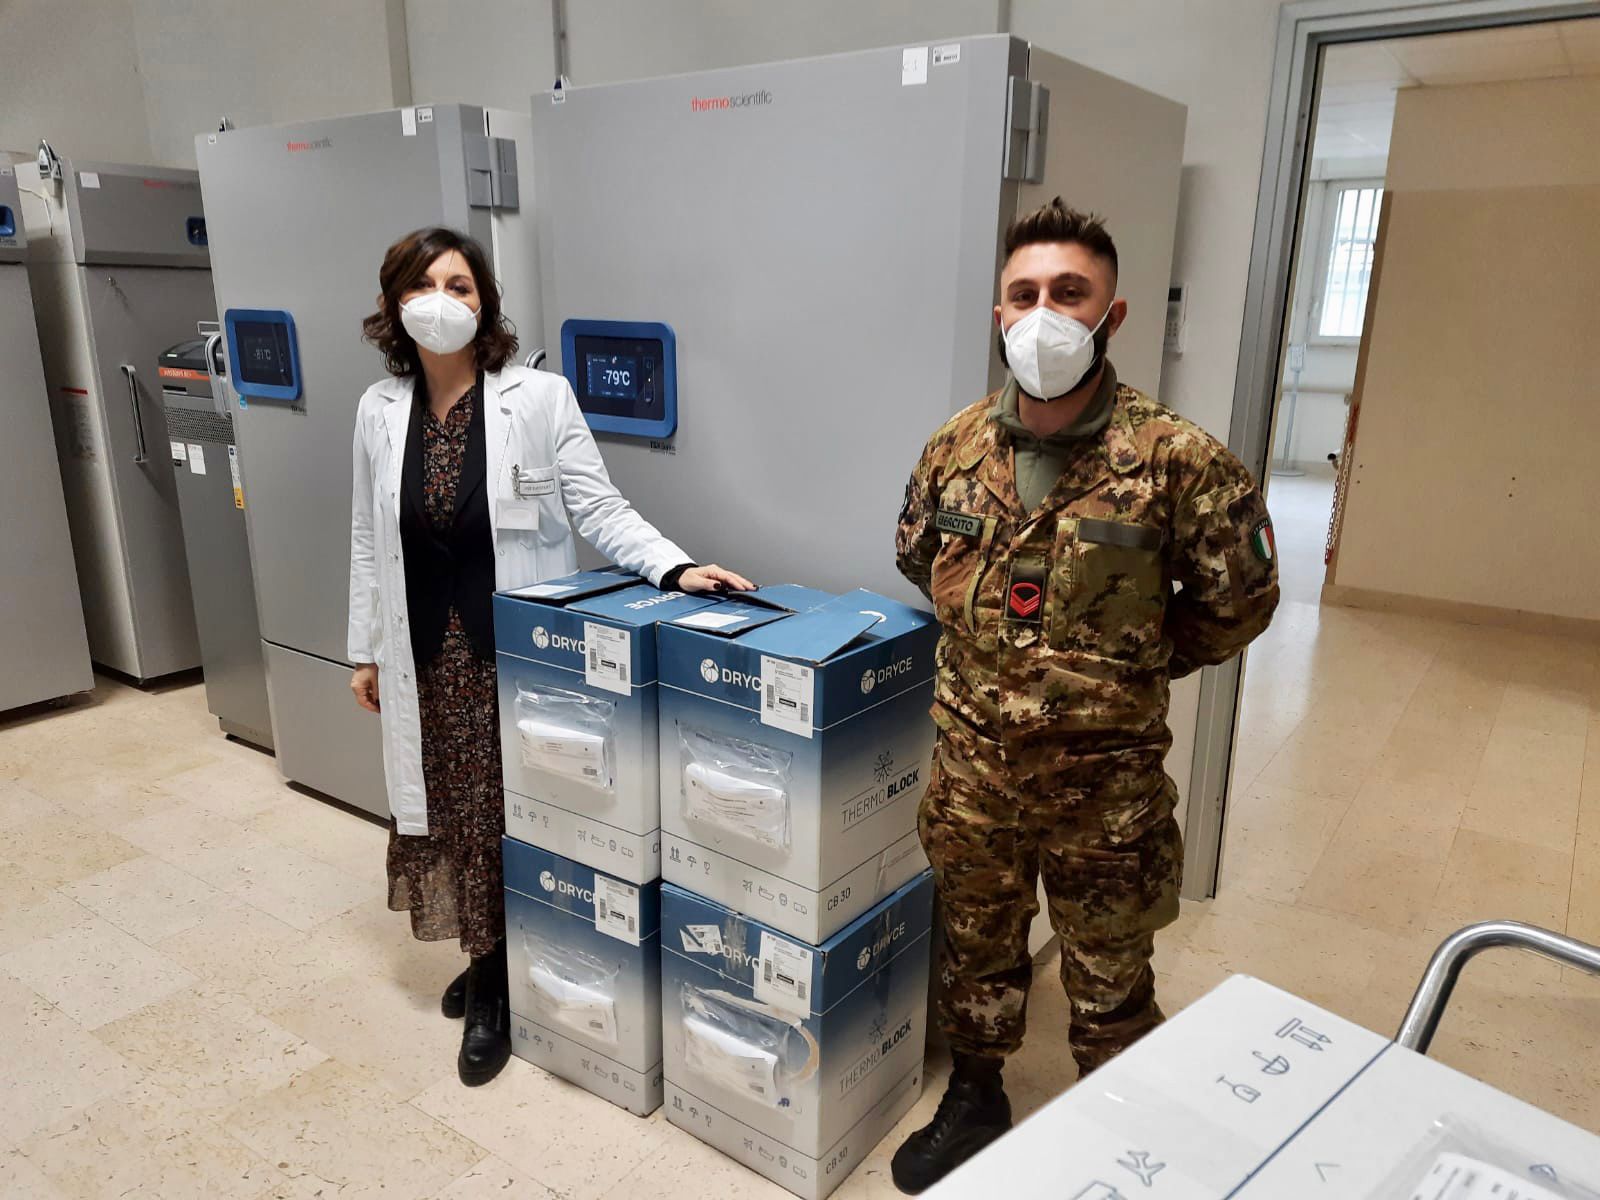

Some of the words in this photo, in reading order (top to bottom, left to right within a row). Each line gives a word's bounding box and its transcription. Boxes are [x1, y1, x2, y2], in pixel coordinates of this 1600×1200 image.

[691, 89, 773, 112] thermoscientific
[602, 370, 631, 386] -79°C
[877, 656, 913, 684] DRYCE
[842, 789, 885, 824] THERMO
[887, 767, 920, 799] BLOCK
[827, 895, 839, 911] CB
[840, 887, 851, 903] 30
[841, 1049, 880, 1093] THERMO
[882, 1018, 912, 1056] BLOCK
